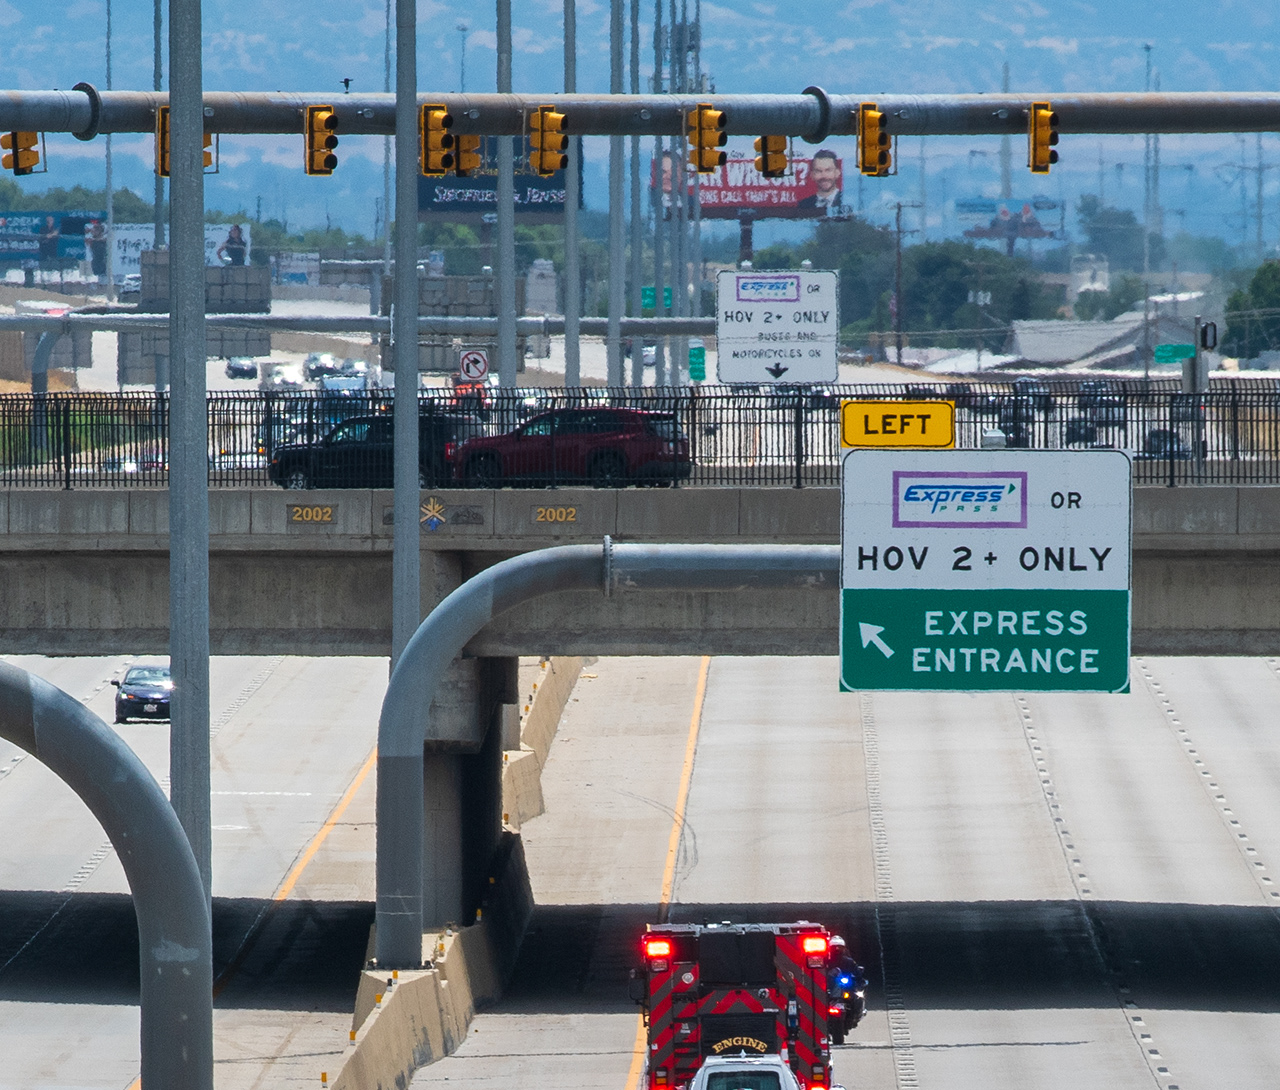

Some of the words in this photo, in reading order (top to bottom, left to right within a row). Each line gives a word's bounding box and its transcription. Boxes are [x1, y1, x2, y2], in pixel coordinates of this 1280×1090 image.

[780, 191, 797, 204] ALL
[807, 284, 821, 294] OR
[724, 310, 754, 323] HOV
[792, 310, 830, 323] ONLY
[732, 348, 803, 359] MOTORCYCLES
[808, 349, 821, 358] OK
[863, 414, 932, 435] LEFT
[904, 484, 1006, 514] Express
[1050, 491, 1082, 509] OR
[292, 506, 333, 522] 2002
[536, 507, 577, 522] 2002
[857, 546, 929, 571] HOV
[1019, 546, 1113, 571] ONLY
[924, 610, 1089, 636] EXPRESS
[911, 647, 1100, 674] ENTRANCE
[711, 1036, 768, 1054] ENGINE
